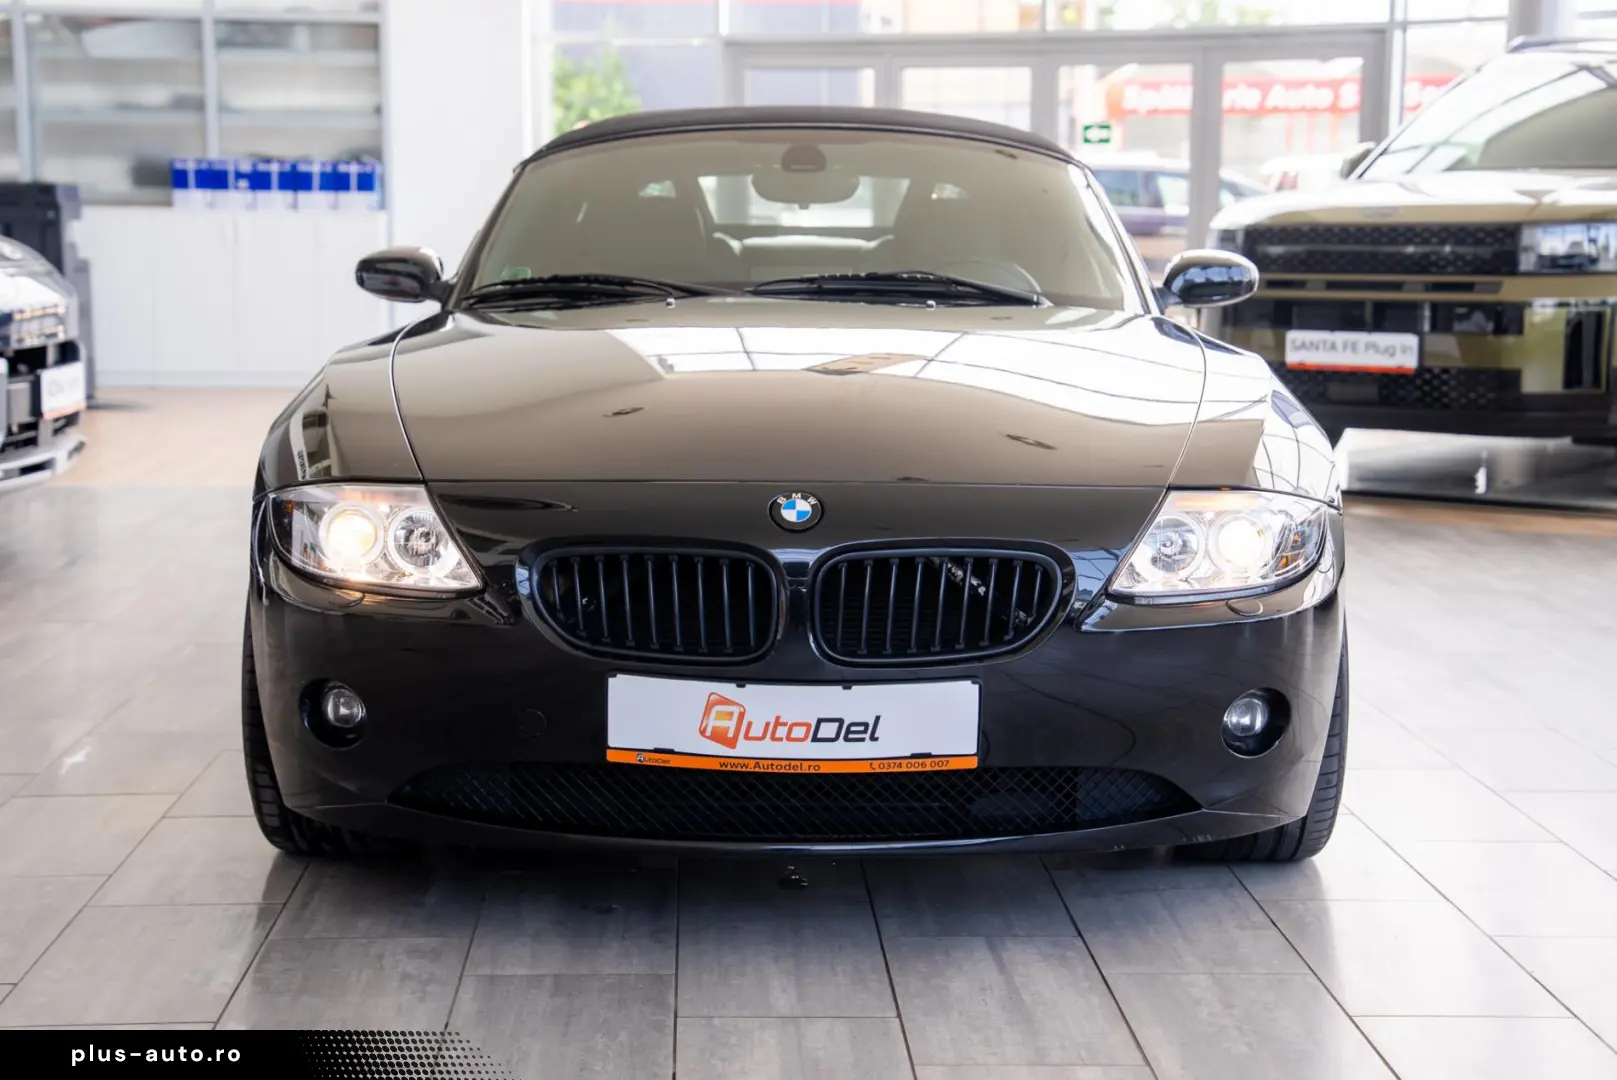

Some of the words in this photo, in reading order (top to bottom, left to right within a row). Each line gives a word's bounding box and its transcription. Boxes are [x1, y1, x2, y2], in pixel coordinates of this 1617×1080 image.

[1265, 83, 1334, 110] Auto
[1290, 339, 1338, 352] SANTA
[1342, 340, 1361, 355] FE
[1364, 340, 1398, 358] Plug
[776, 492, 818, 505] BMW
[703, 702, 882, 744] AutoDel
[719, 760, 821, 772] www.Autodel.ro
[878, 761, 902, 770] 0374
[905, 760, 927, 769] 006
[929, 759, 949, 768] 007
